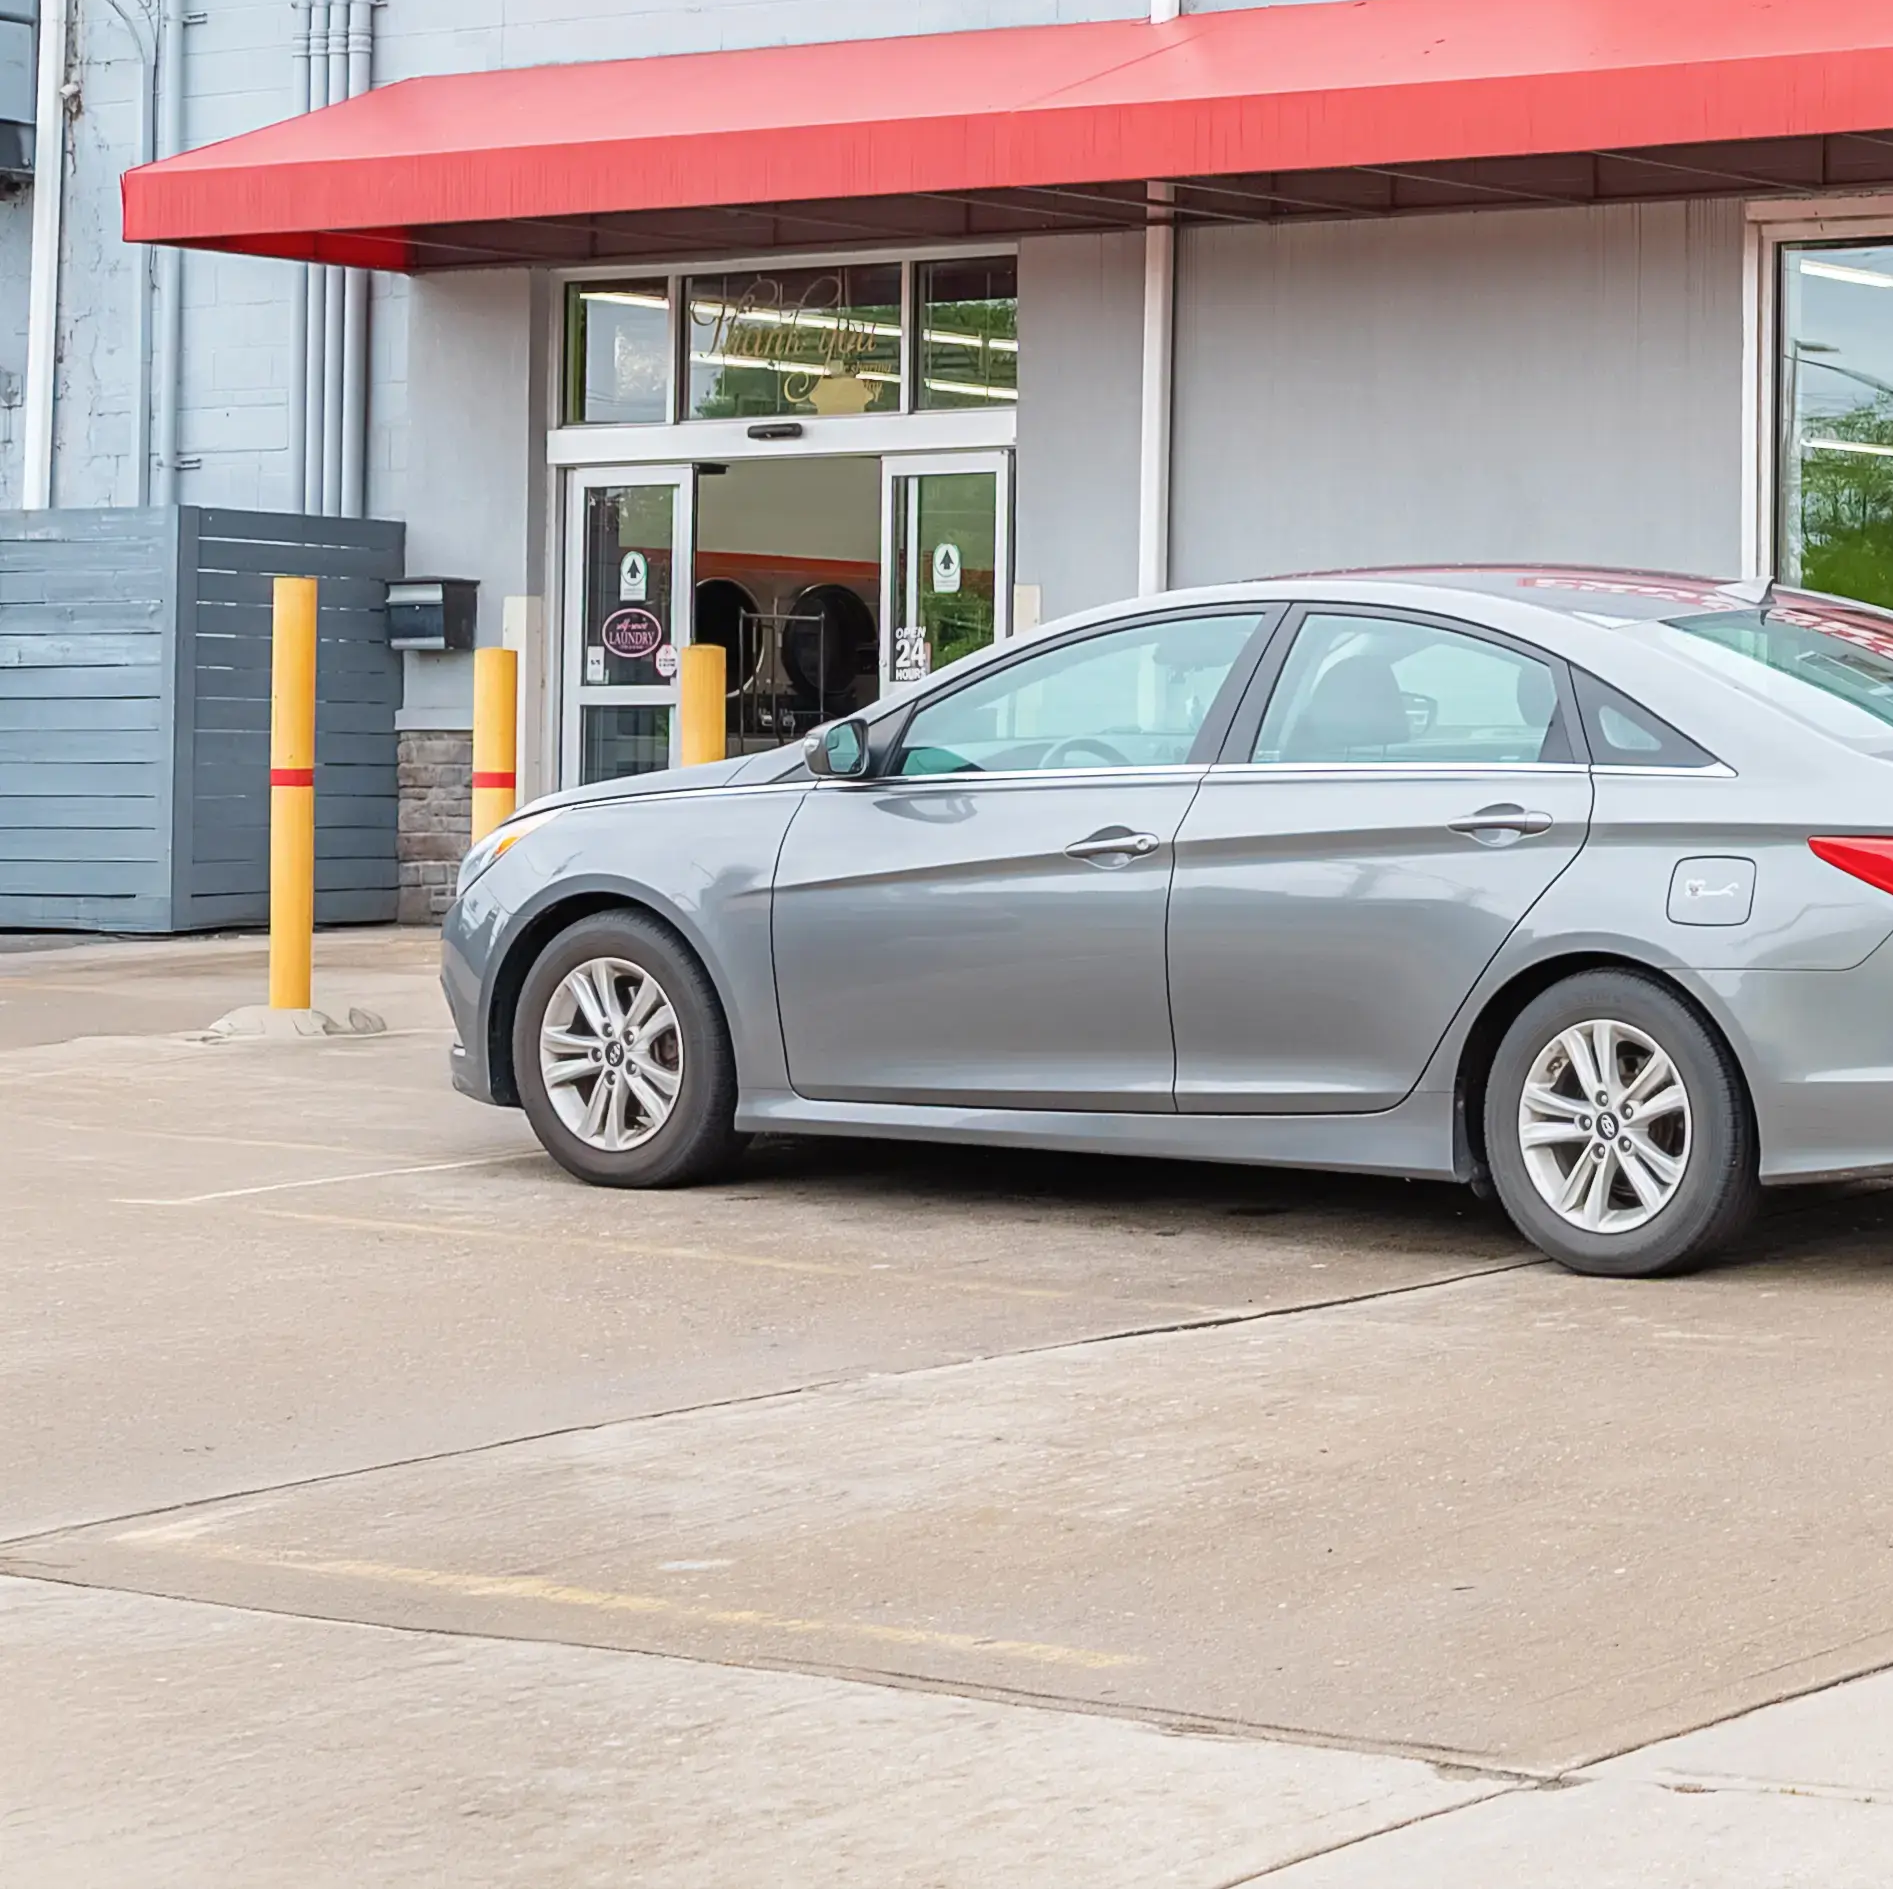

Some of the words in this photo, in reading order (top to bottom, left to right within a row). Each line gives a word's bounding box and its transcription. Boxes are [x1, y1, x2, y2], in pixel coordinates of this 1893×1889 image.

[691, 274, 838, 359] Thank
[609, 631, 655, 646] LAUNDRY
[895, 626, 927, 639] OPEN
[895, 638, 927, 668] 24
[895, 667, 928, 681] HOURS
